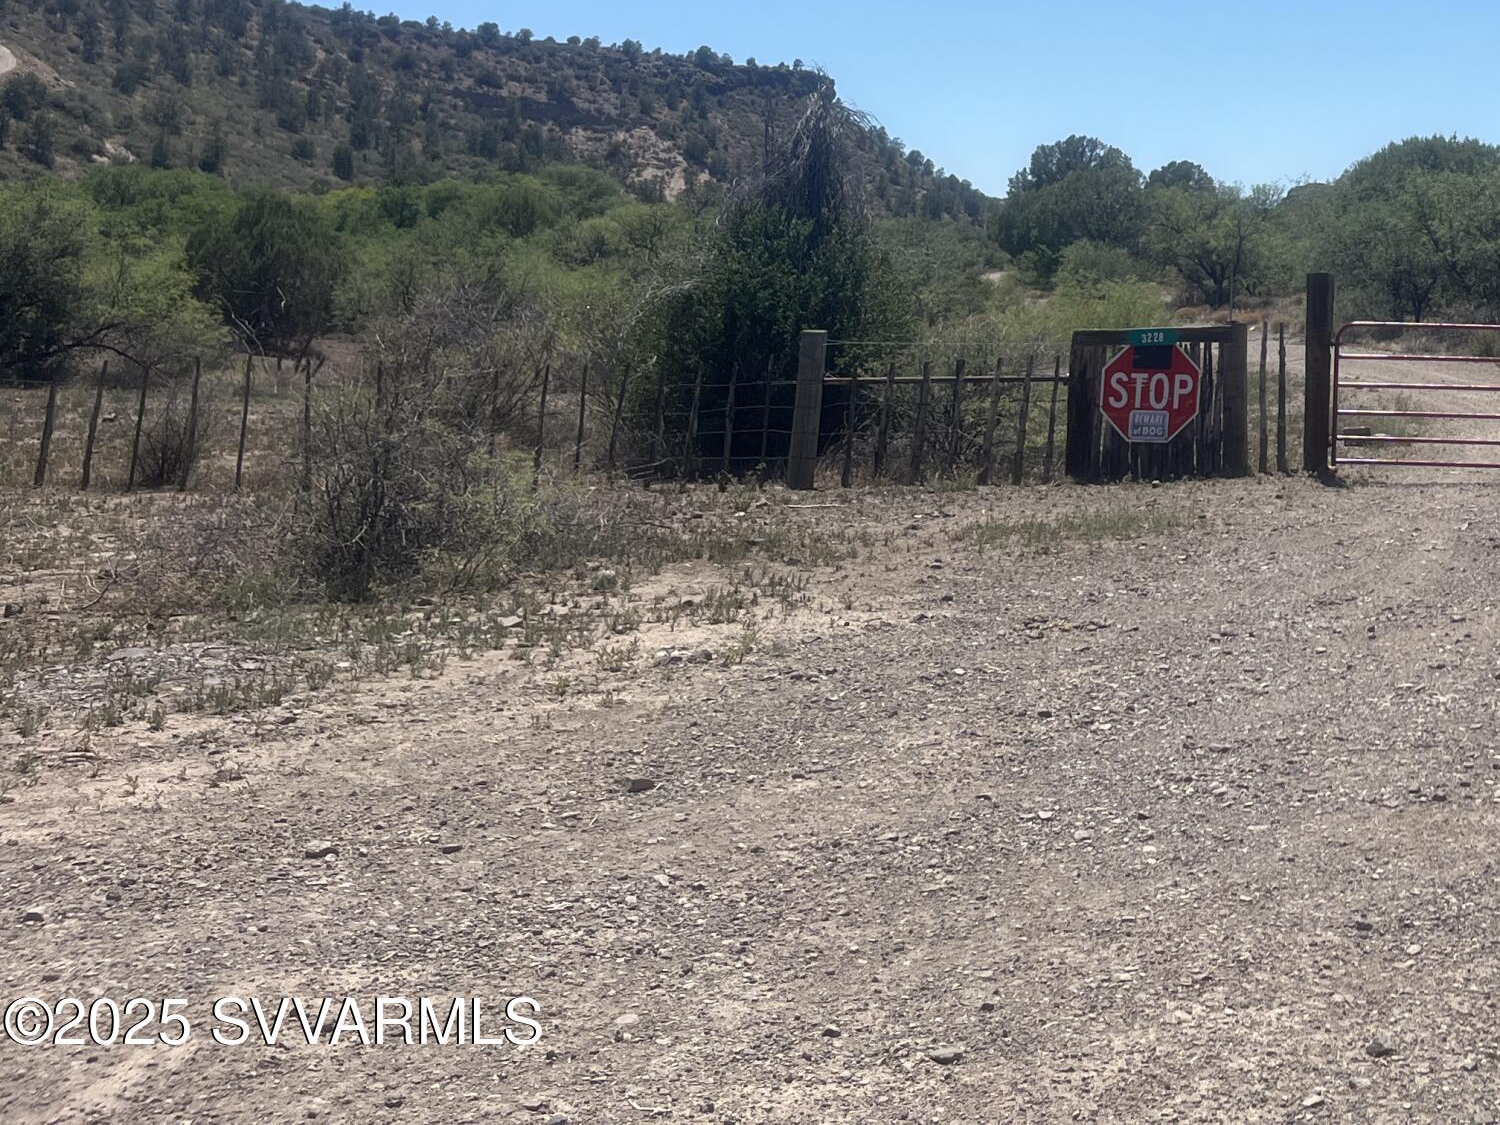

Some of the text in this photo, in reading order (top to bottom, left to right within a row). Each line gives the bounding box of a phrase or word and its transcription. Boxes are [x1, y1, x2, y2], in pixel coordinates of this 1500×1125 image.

[1108, 371, 1194, 410] STOP
[1134, 413, 1164, 425] BEWARE
[1133, 426, 1163, 436] of DOG
